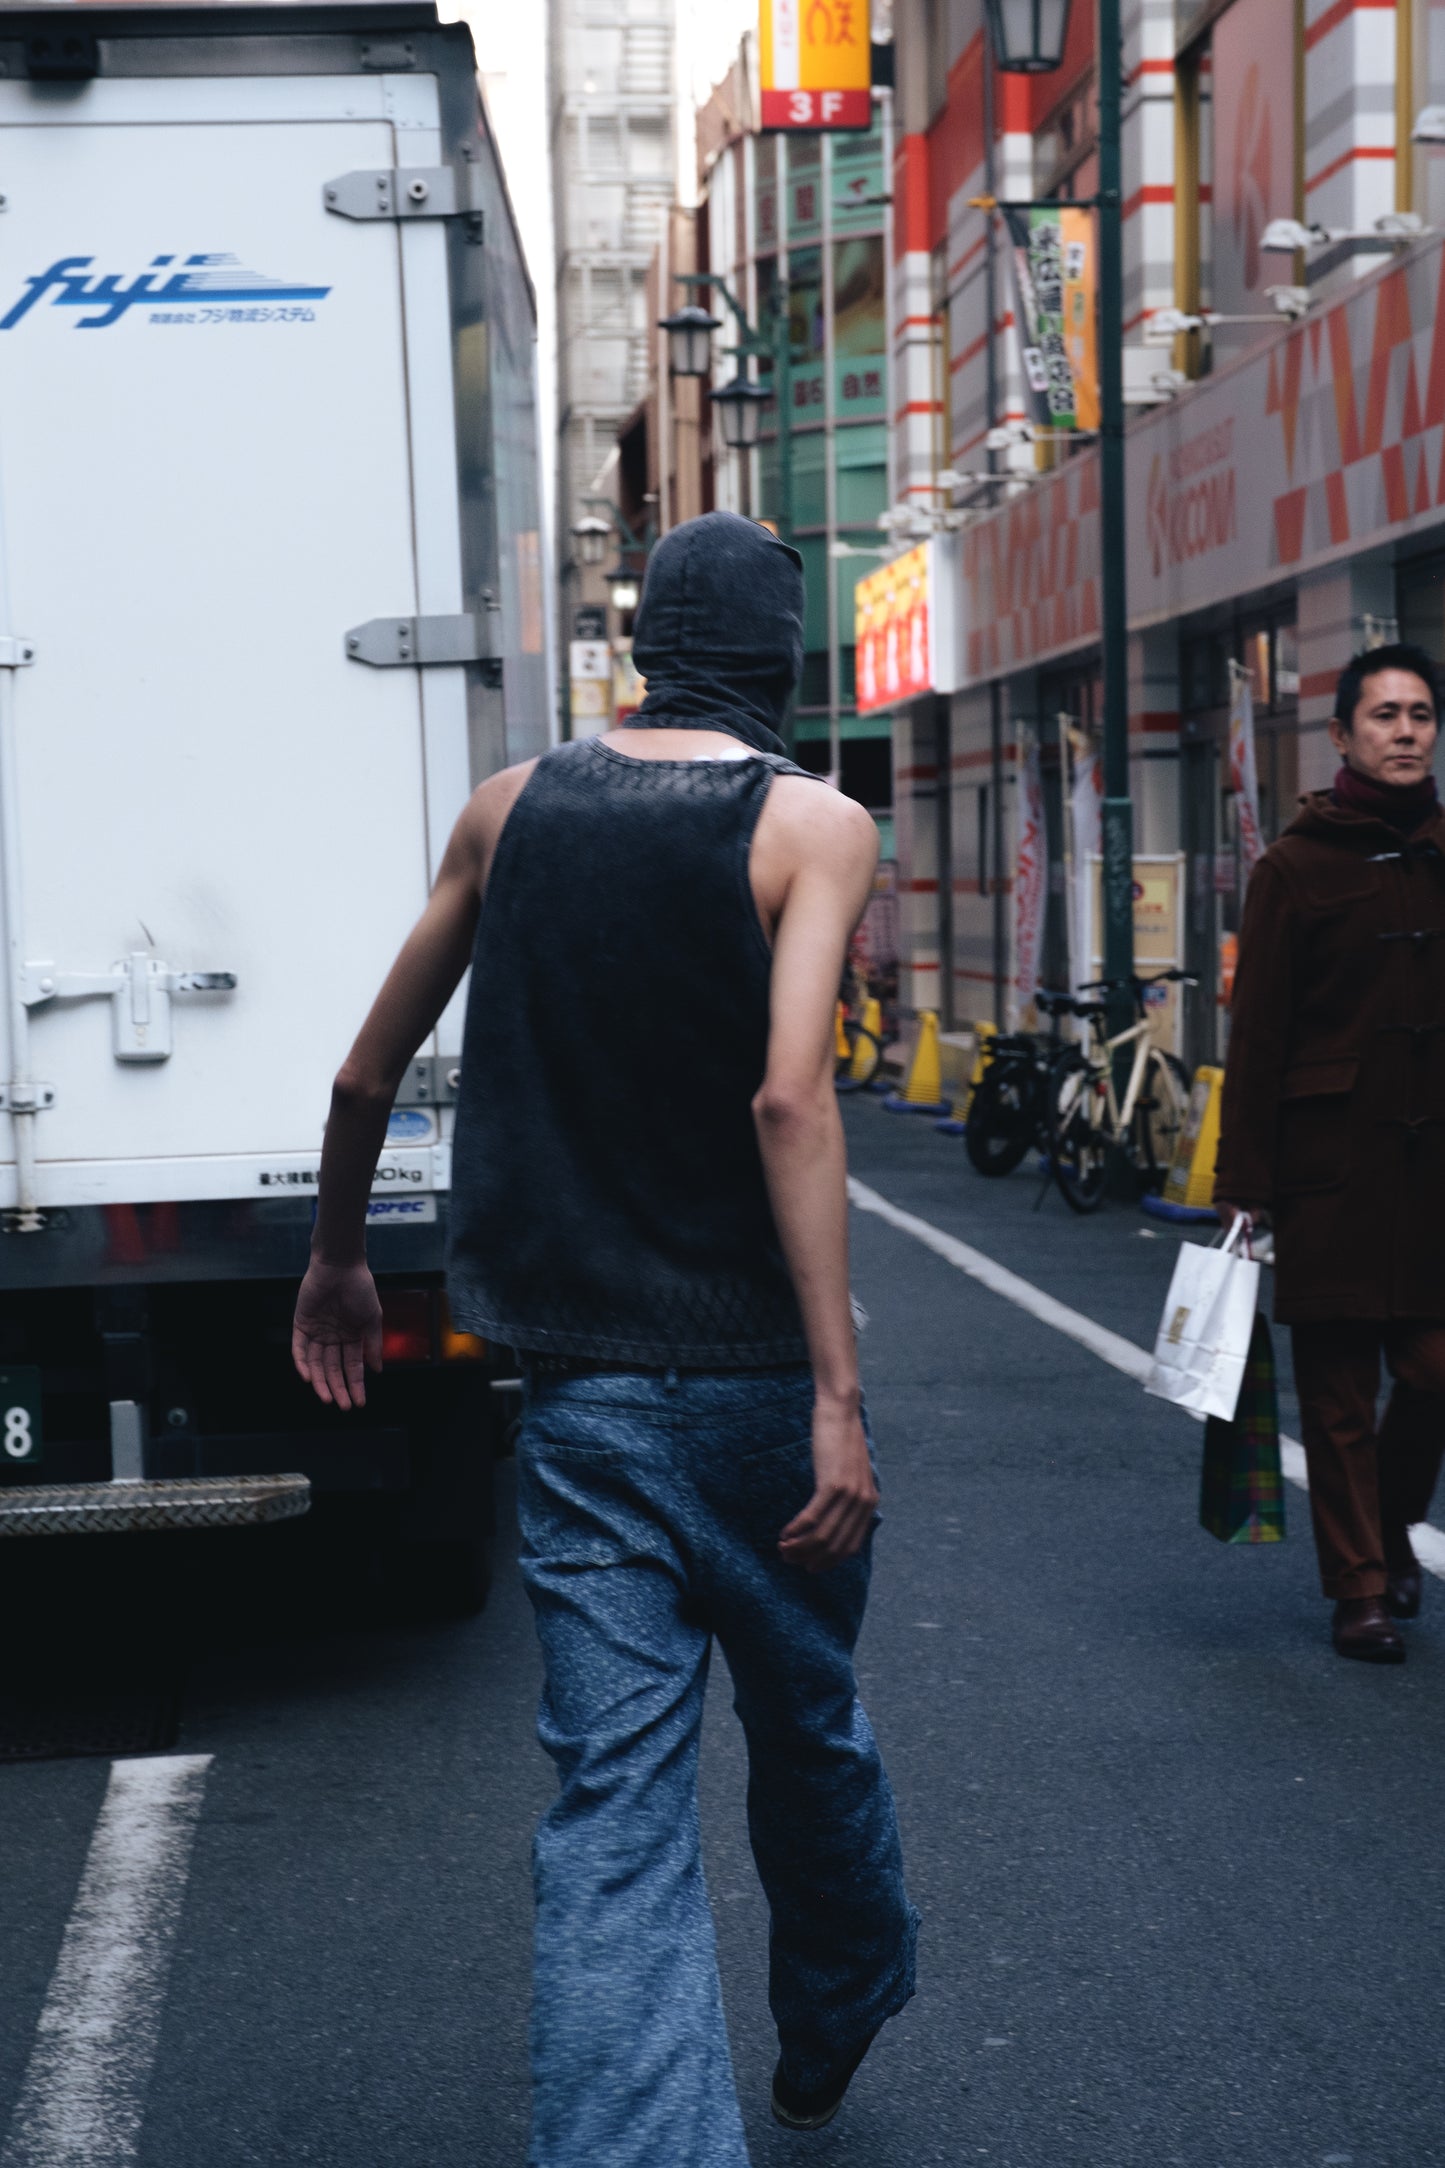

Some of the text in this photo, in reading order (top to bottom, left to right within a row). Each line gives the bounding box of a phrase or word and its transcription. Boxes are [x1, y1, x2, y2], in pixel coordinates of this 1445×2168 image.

[788, 91, 844, 122] 3F
[260, 1170, 320, 1186] 最大積載
[4, 1407, 32, 1458] 8
